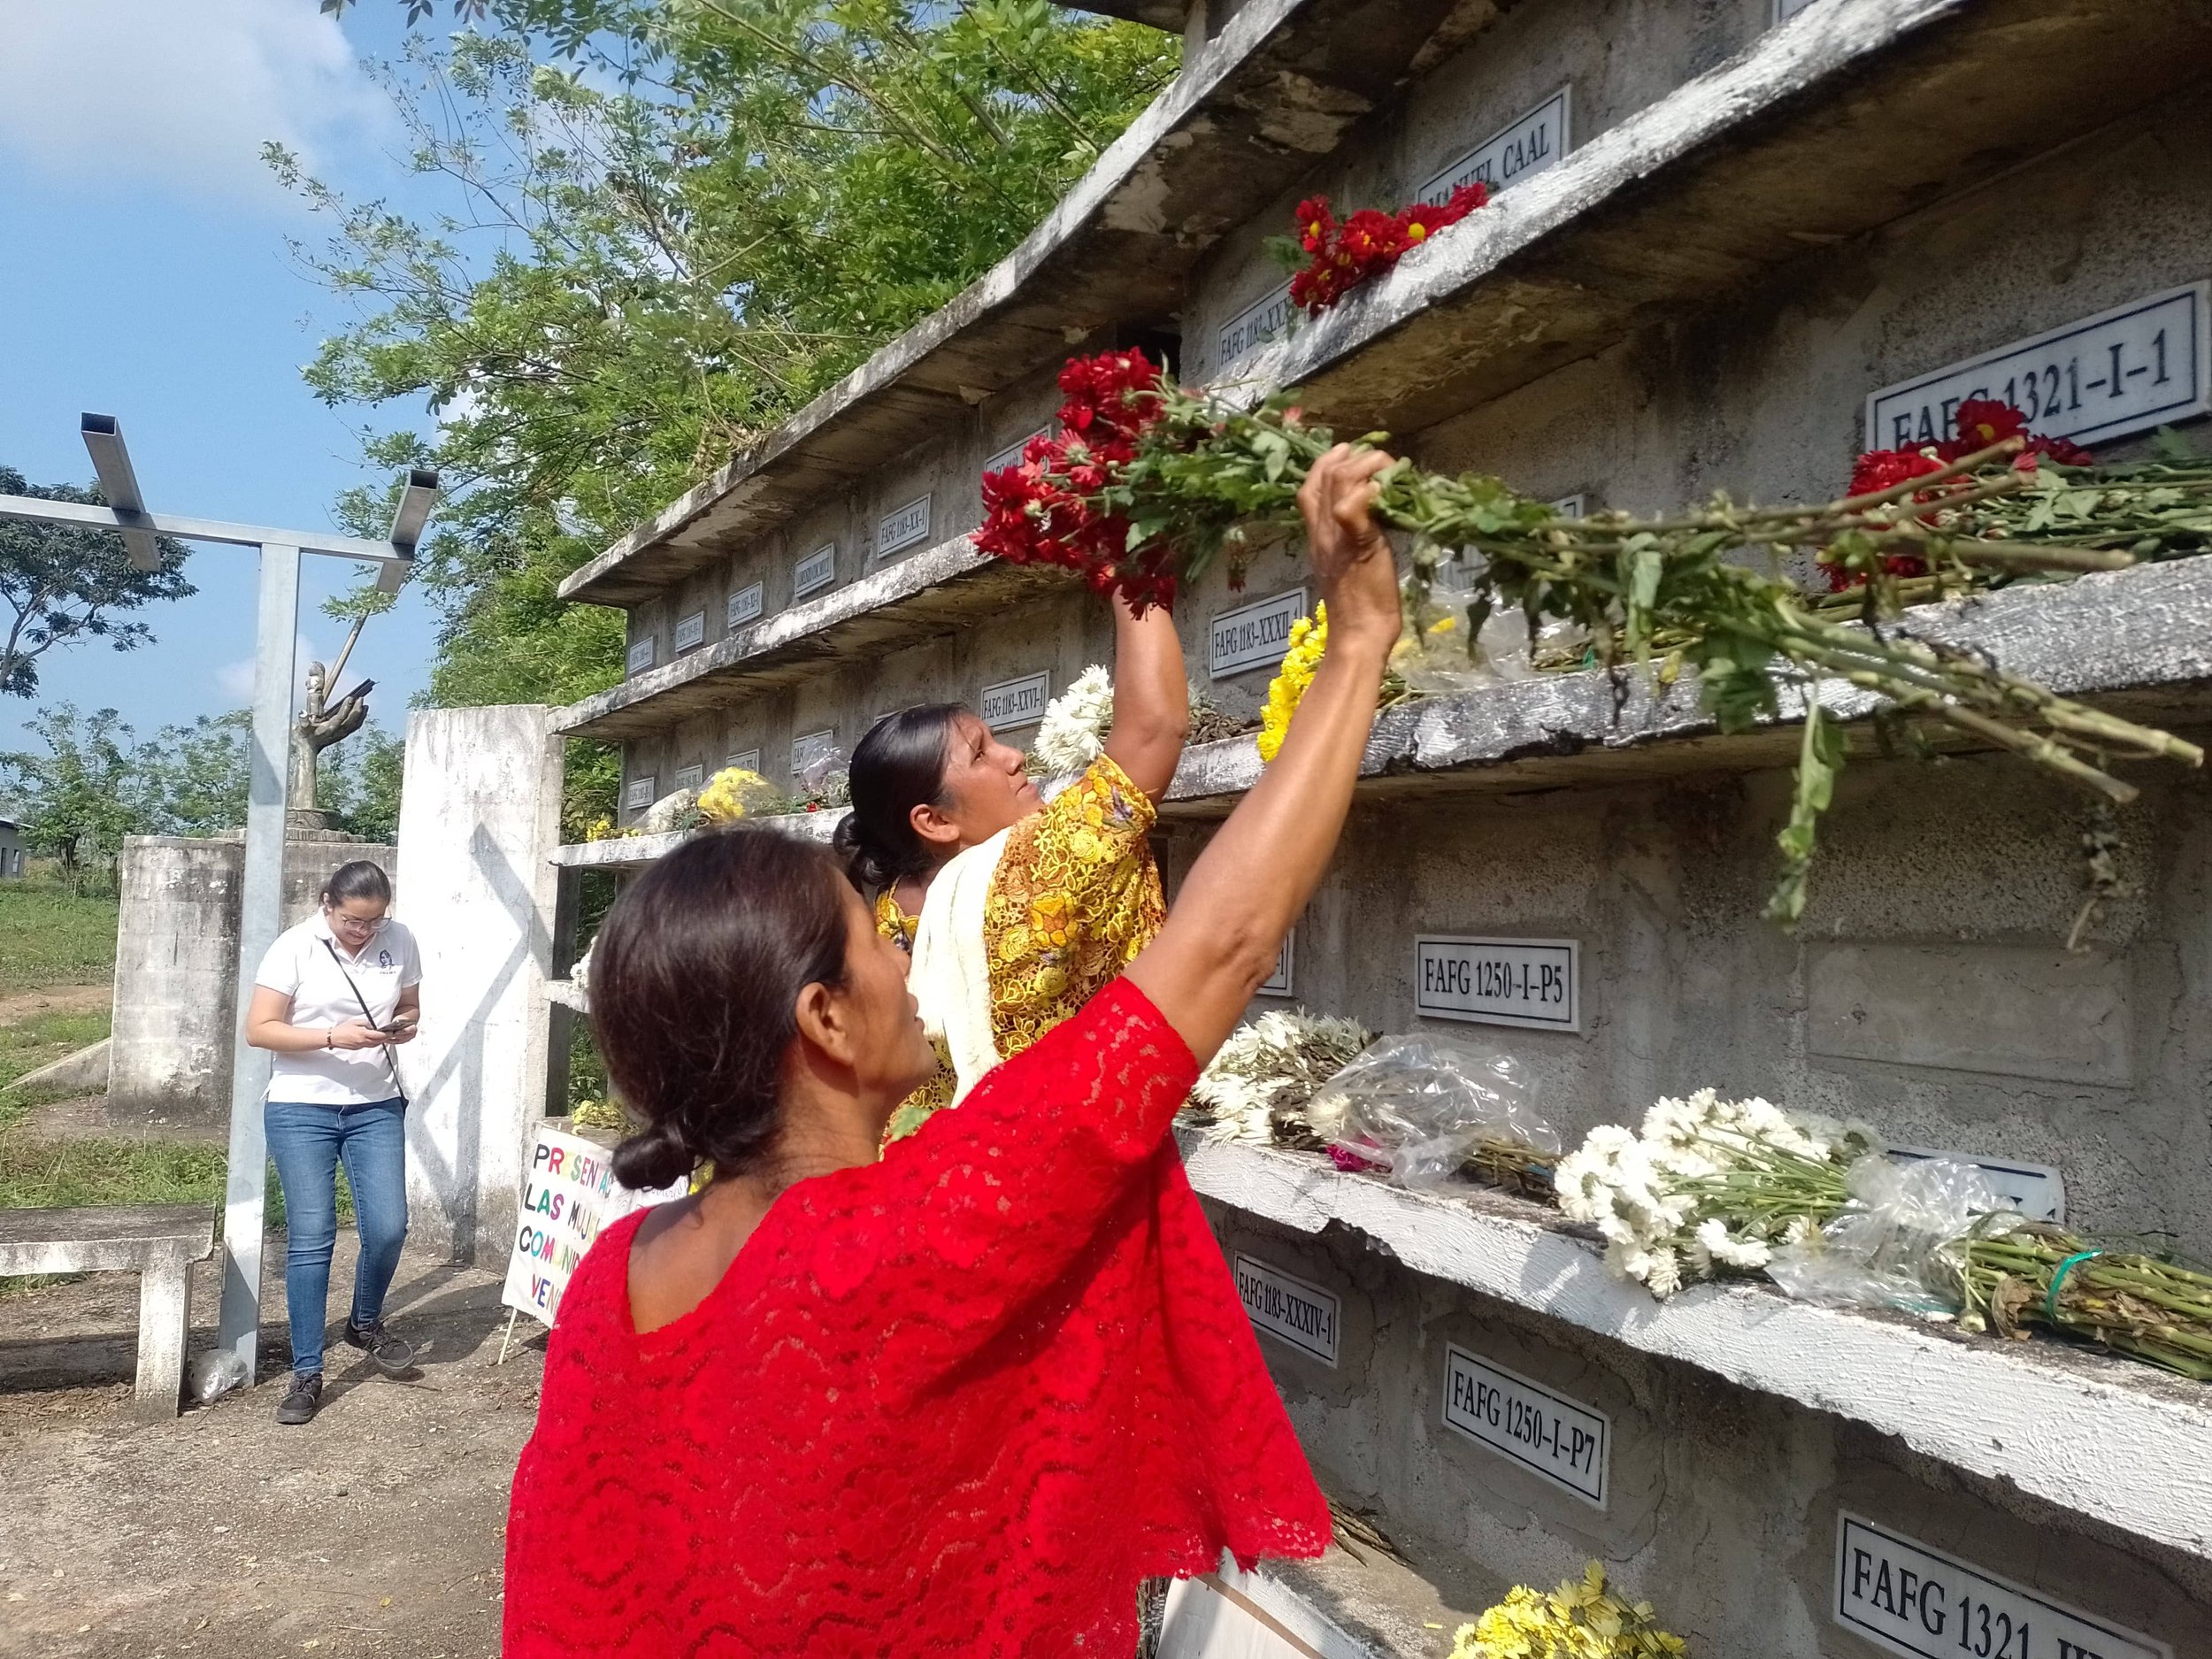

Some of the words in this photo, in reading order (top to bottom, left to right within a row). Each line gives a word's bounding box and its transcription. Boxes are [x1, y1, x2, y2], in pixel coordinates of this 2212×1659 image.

[1503, 122, 1549, 179] CAAL
[1220, 327, 1244, 366] FAFG
[1892, 388, 1989, 452] FAF
[2003, 328, 2170, 425] 1321-I-1
[1215, 626, 1238, 659] FAFG
[983, 695, 1002, 720] FAFG
[1425, 958, 1471, 995] FAFG
[1476, 960, 1563, 1003] 1250-I-P5
[524, 1182, 565, 1221] LAS
[1239, 1271, 1263, 1310] FAFG
[1263, 1283, 1332, 1345] 1183-XXXIV-1
[1453, 1370, 1501, 1427] FAFG
[1505, 1395, 1595, 1475] 1250-I-P7
[1852, 1547, 1947, 1636] FAFG
